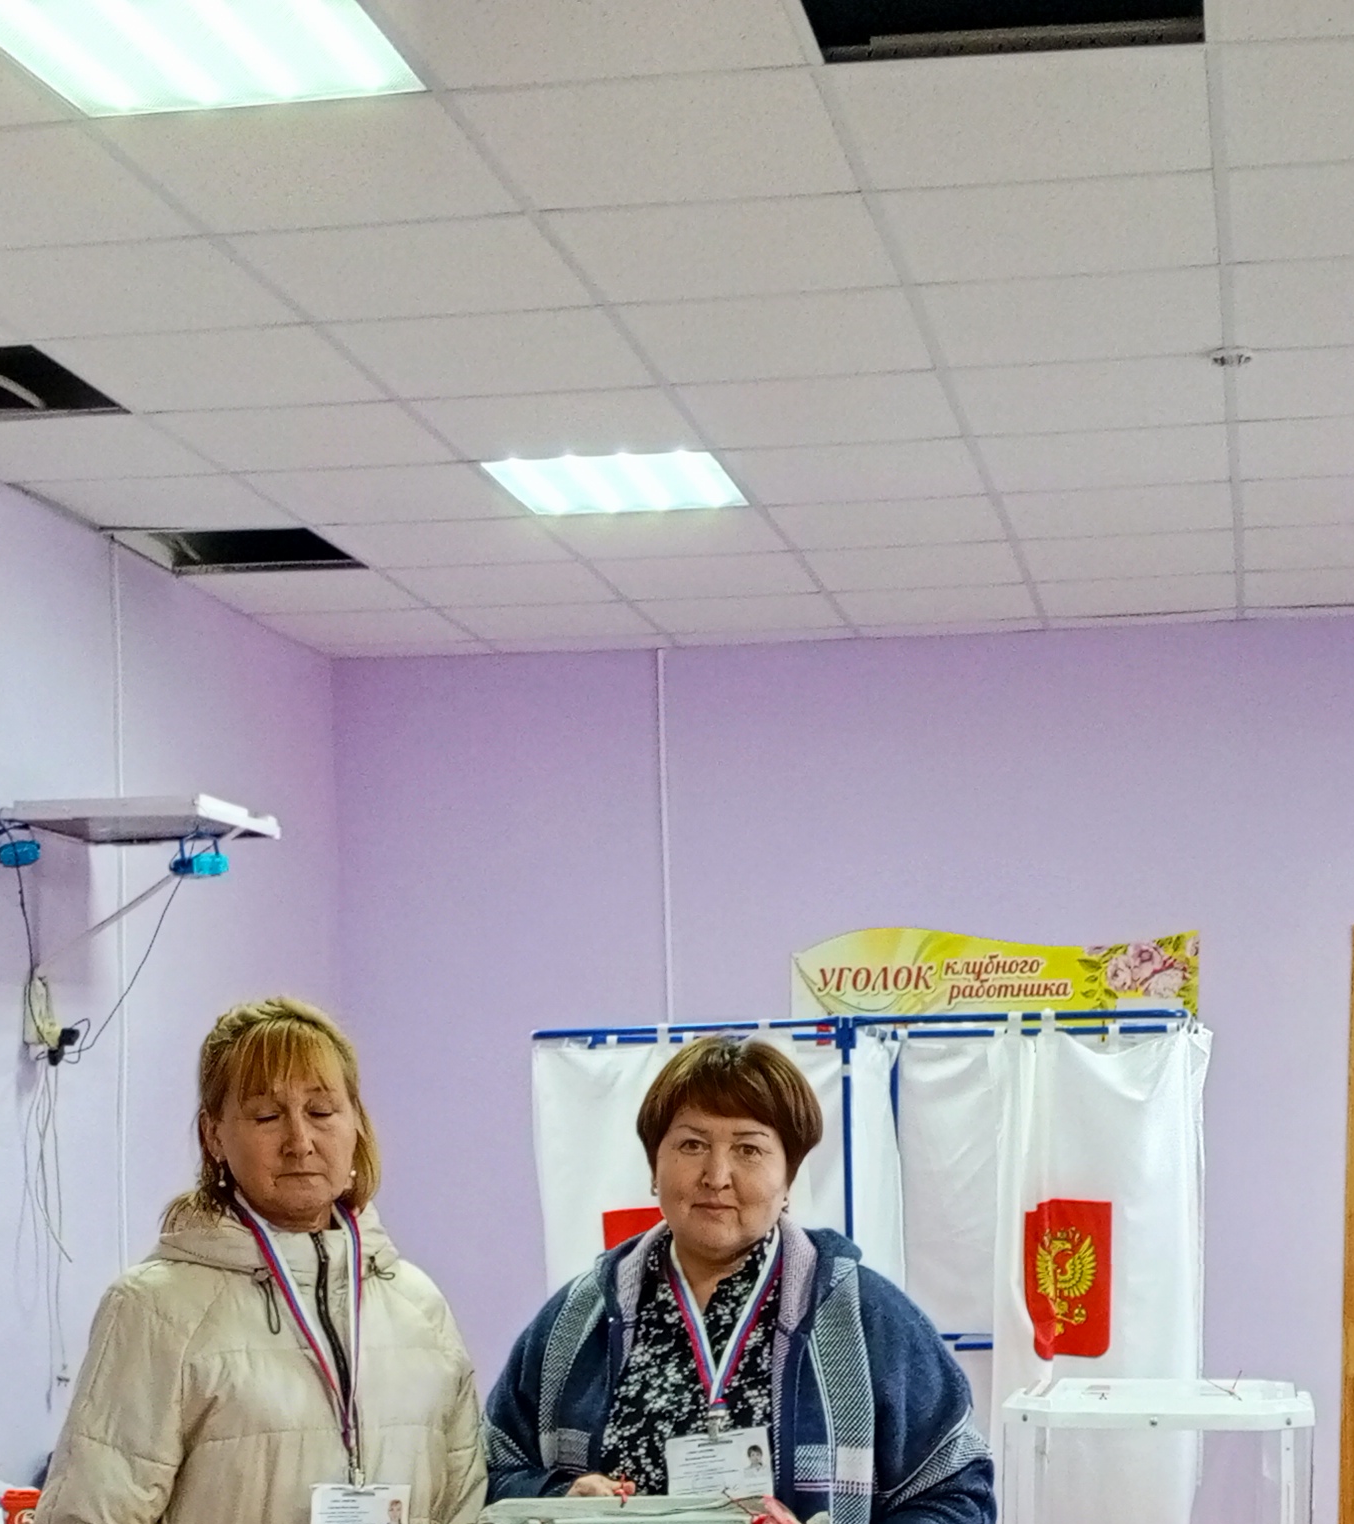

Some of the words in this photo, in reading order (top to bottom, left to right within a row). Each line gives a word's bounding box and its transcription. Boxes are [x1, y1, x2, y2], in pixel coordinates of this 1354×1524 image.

[817, 964, 934, 993] УГОЛОК
[944, 954, 1044, 981] клубного
[947, 979, 1071, 1006] работника
